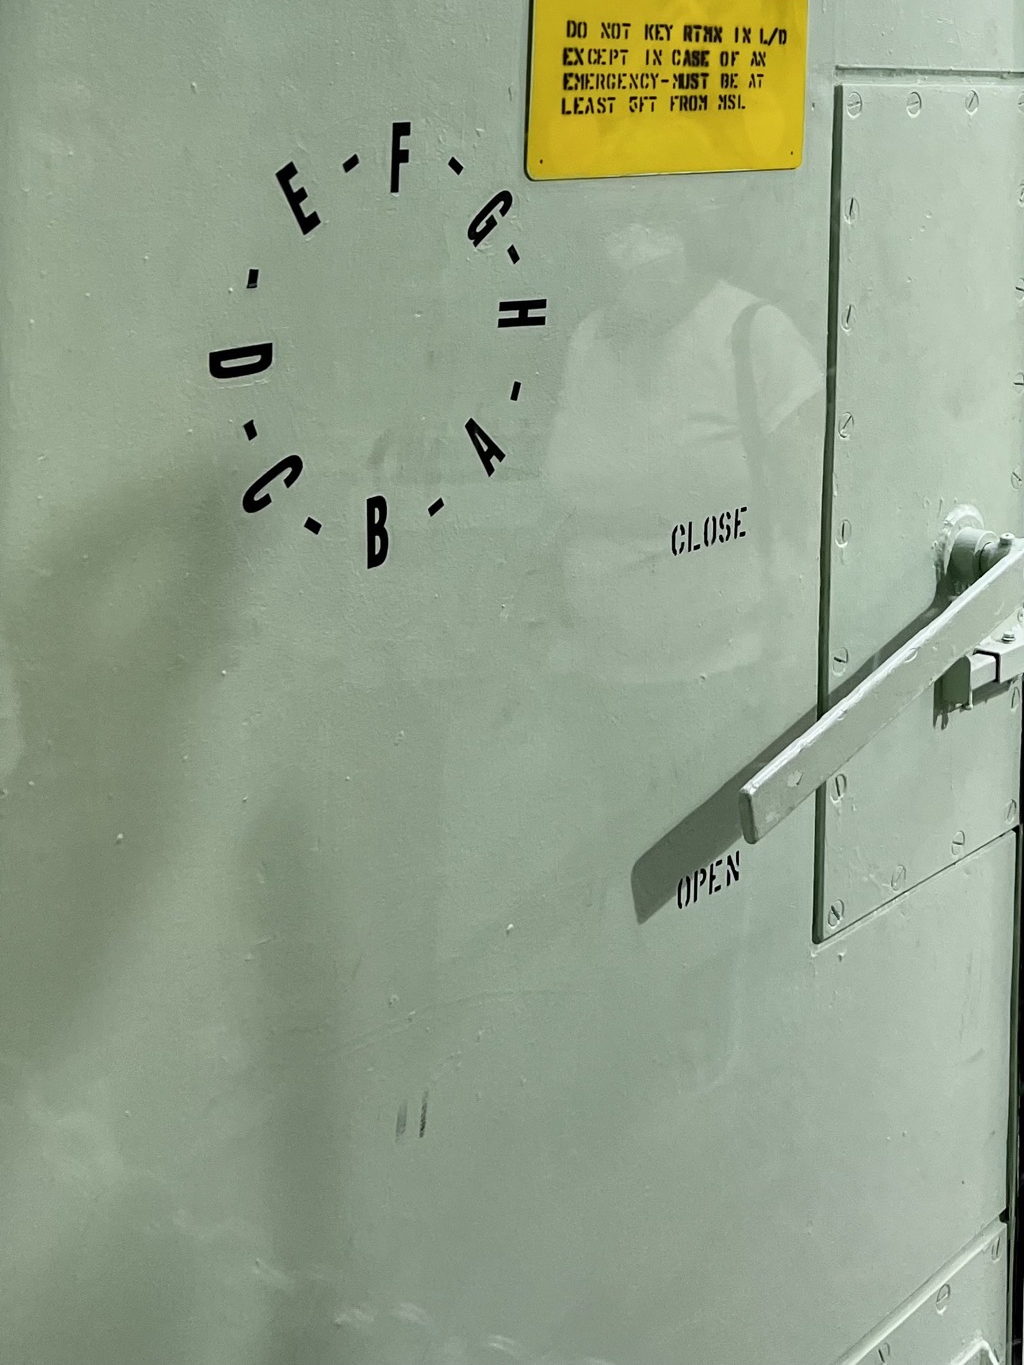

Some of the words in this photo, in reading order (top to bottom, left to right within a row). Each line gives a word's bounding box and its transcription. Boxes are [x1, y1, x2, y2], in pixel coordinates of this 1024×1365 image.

[562, 46, 629, 66] EXCEPT
[645, 48, 663, 66] IN
[671, 49, 710, 67] CASE
[720, 50, 740, 67] OF
[750, 51, 767, 67] AN
[566, 20, 588, 39] DO
[600, 21, 631, 40] NOT
[644, 23, 673, 41] KEY
[734, 26, 752, 44] IN
[760, 26, 788, 46] L/D
[561, 96, 616, 115] LEAST
[628, 96, 658, 113] 5FT
[669, 94, 708, 112] FROM
[718, 94, 747, 111] MSL
[720, 73, 738, 89] BE
[749, 74, 764, 89] AT
[391, 122, 411, 193] F
[275, 161, 321, 235] E
[468, 190, 513, 247] G
[498, 299, 547, 328] H
[209, 342, 273, 379] D
[465, 418, 506, 477] A
[242, 454, 303, 513] C
[367, 495, 389, 569] B
[671, 506, 748, 556] CLOSE
[676, 850, 740, 909] OPEN
